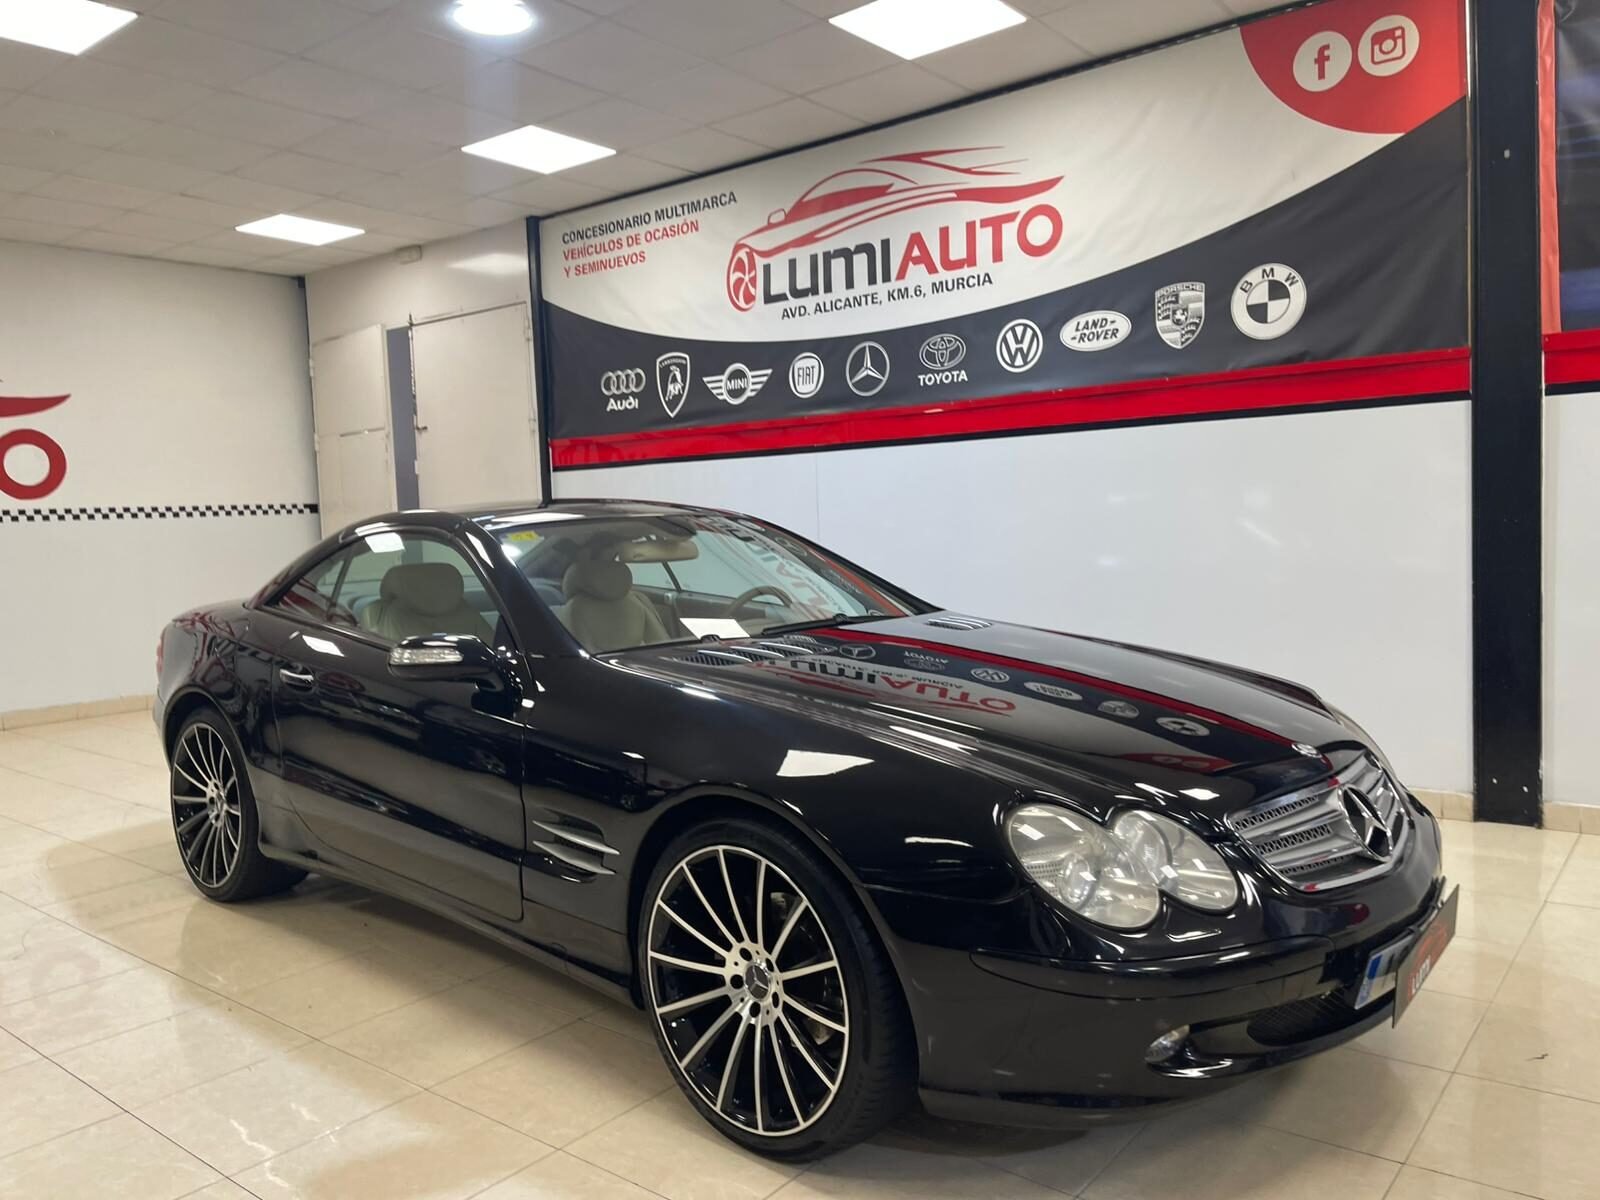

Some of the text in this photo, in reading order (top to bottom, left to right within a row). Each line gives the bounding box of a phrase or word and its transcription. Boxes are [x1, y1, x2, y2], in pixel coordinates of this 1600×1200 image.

[562, 191, 737, 245] CONCESIONARIO MULTIMARCA
[563, 219, 699, 262] VEHÍCULOS DE OCASIÓN
[564, 251, 646, 278] Y SEMINUEVOS
[1239, 267, 1299, 294] BMW
[781, 272, 993, 320] AVD. ALICANTE, KM.6, MURCIA
[726, 378, 748, 391] MINI
[797, 365, 816, 387] FIAT
[918, 370, 968, 386] TOYOTA
[606, 396, 639, 412] Audi
